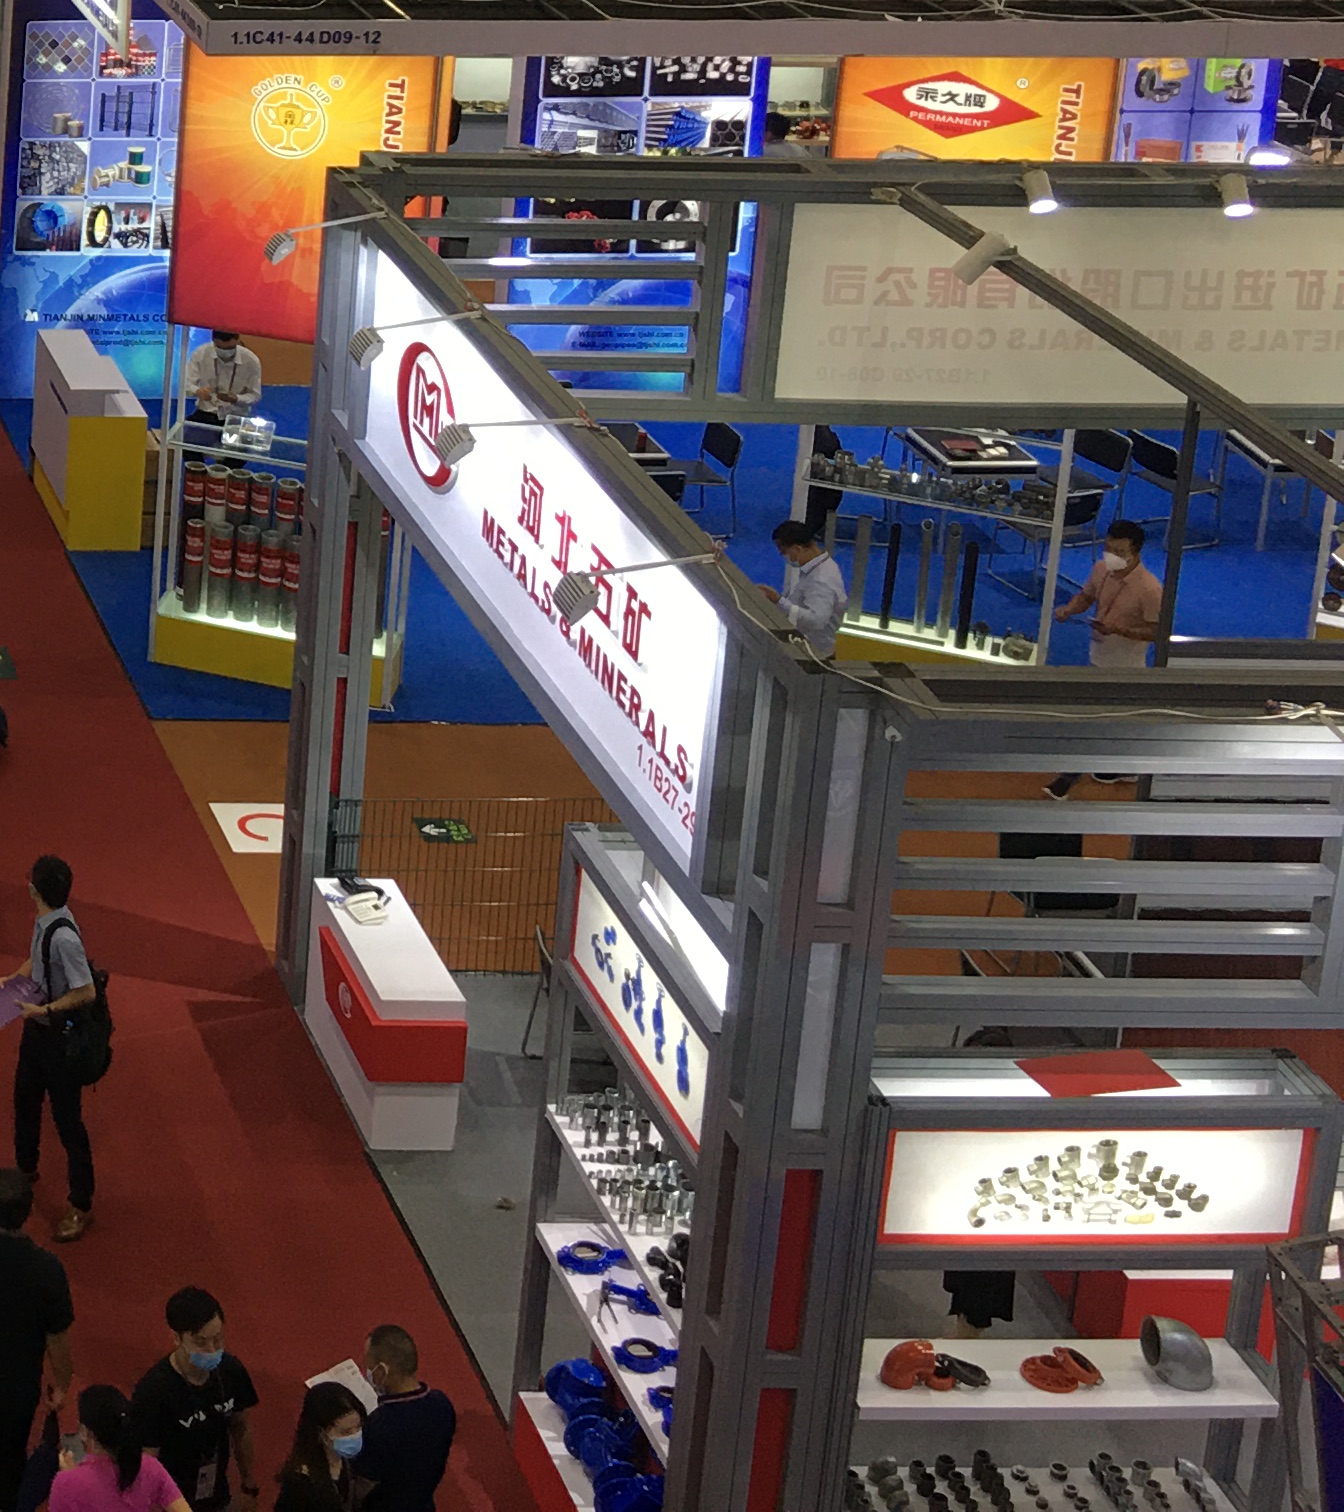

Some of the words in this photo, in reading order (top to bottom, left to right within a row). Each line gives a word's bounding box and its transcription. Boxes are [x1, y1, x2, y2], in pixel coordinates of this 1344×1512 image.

[318, 30, 382, 45] D09-12
[252, 74, 302, 97] GOLDEN
[308, 83, 331, 104] CUP
[908, 110, 991, 128] PERMANENT
[1053, 84, 1083, 162] TIANJ
[42, 313, 84, 323] TIANJIN
[86, 313, 150, 323] MINMETALS
[482, 508, 553, 618] METALS
[578, 633, 691, 785] MINERALS
